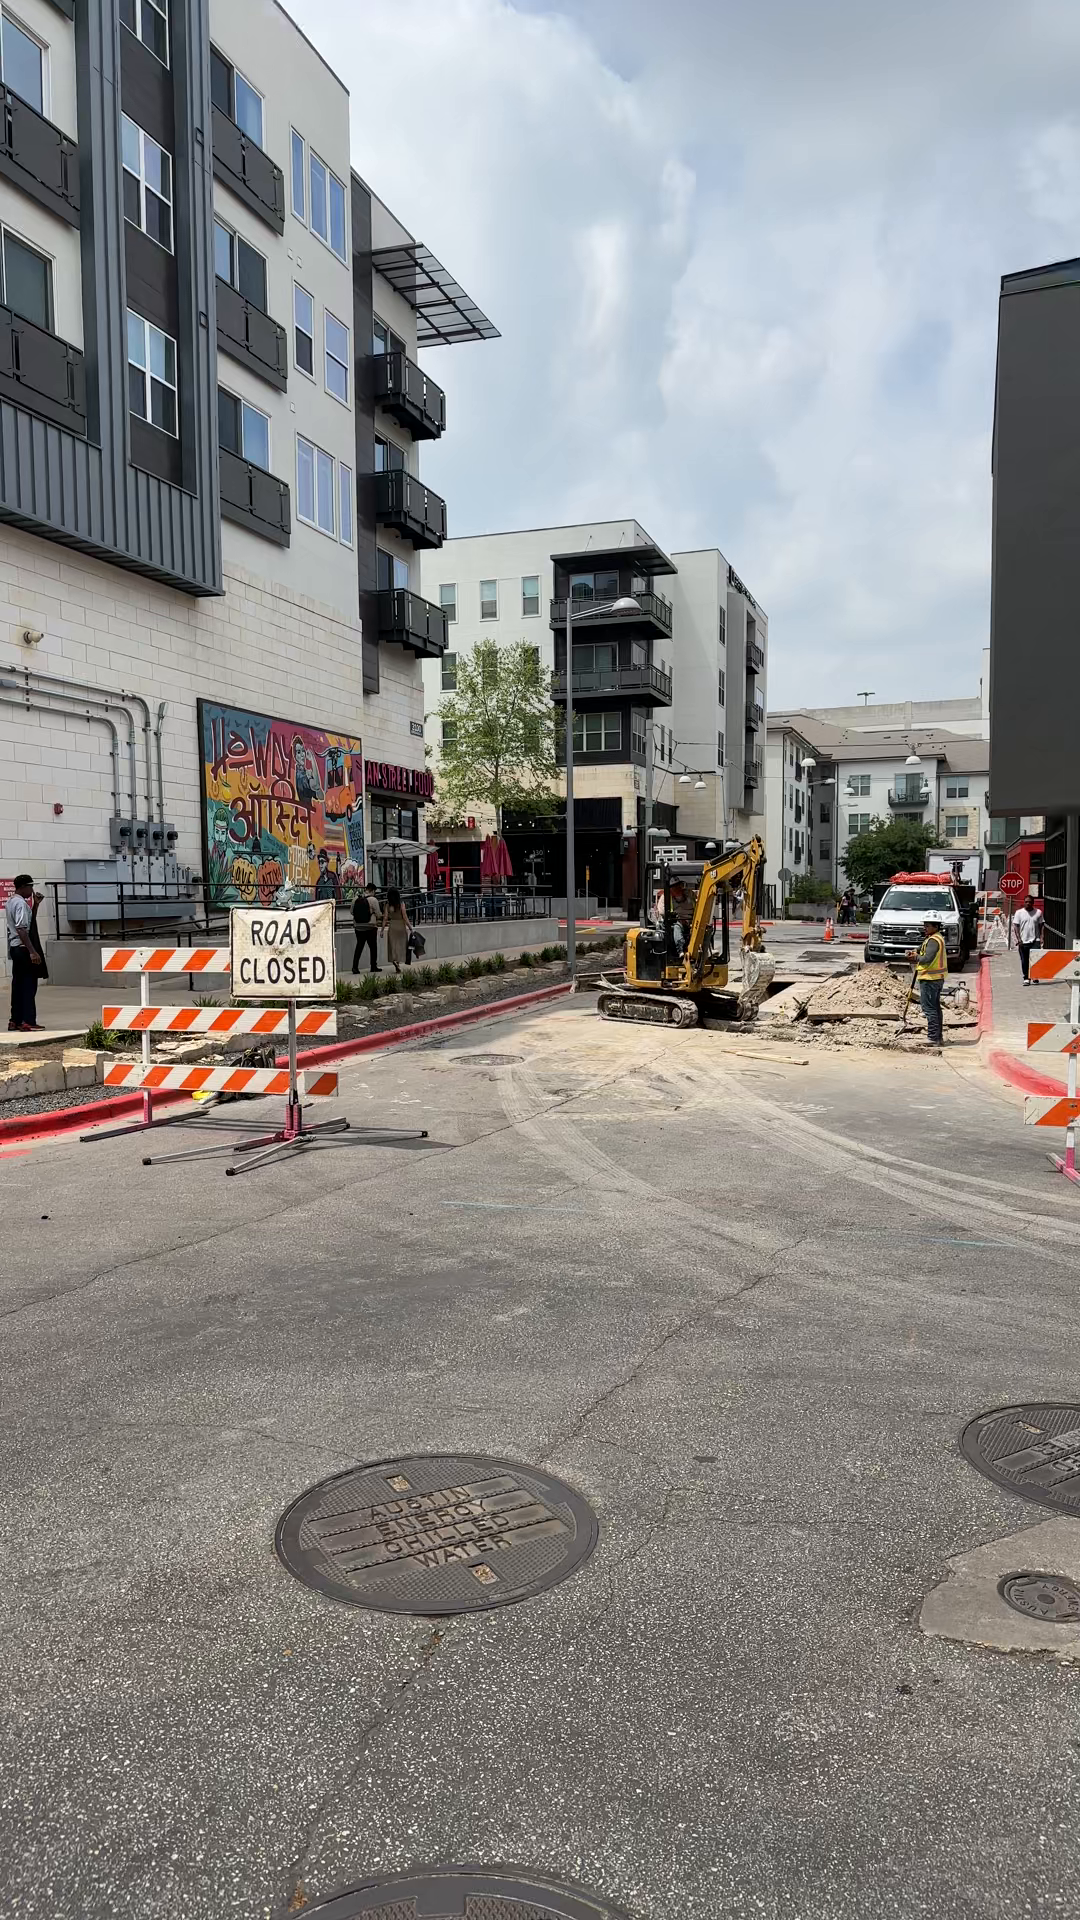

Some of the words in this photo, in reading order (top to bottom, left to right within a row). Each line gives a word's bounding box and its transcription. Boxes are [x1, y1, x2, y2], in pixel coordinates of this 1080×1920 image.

[366, 760, 380, 787] AN
[381, 763, 413, 793] STREET
[414, 769, 435, 797] FOOD
[1001, 879, 1023, 889] STOP
[251, 917, 311, 946] ROAD
[240, 956, 326, 984] CLOSED
[370, 1486, 471, 1520] AUSTIN
[376, 1500, 486, 1537] ENERGY
[384, 1514, 510, 1554] CHILLED
[413, 1535, 512, 1568] WATER
